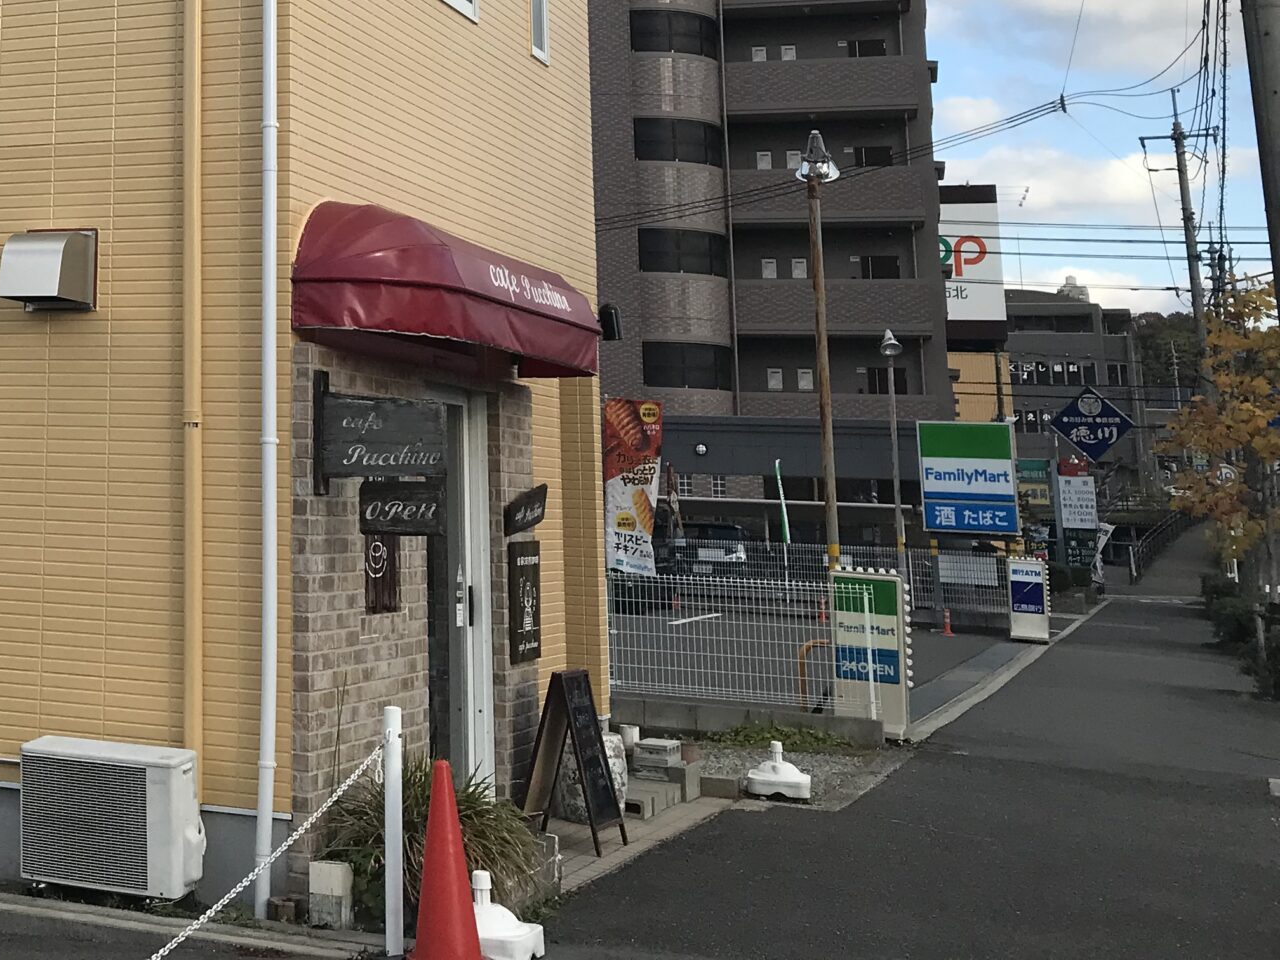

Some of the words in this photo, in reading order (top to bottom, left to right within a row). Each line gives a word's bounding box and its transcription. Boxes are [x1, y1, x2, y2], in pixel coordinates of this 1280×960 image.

[1068, 424, 1119, 445] 徳川
[924, 467, 1010, 486] FamilyMart
[935, 506, 956, 526] 酒
[963, 509, 1009, 526] たばこ
